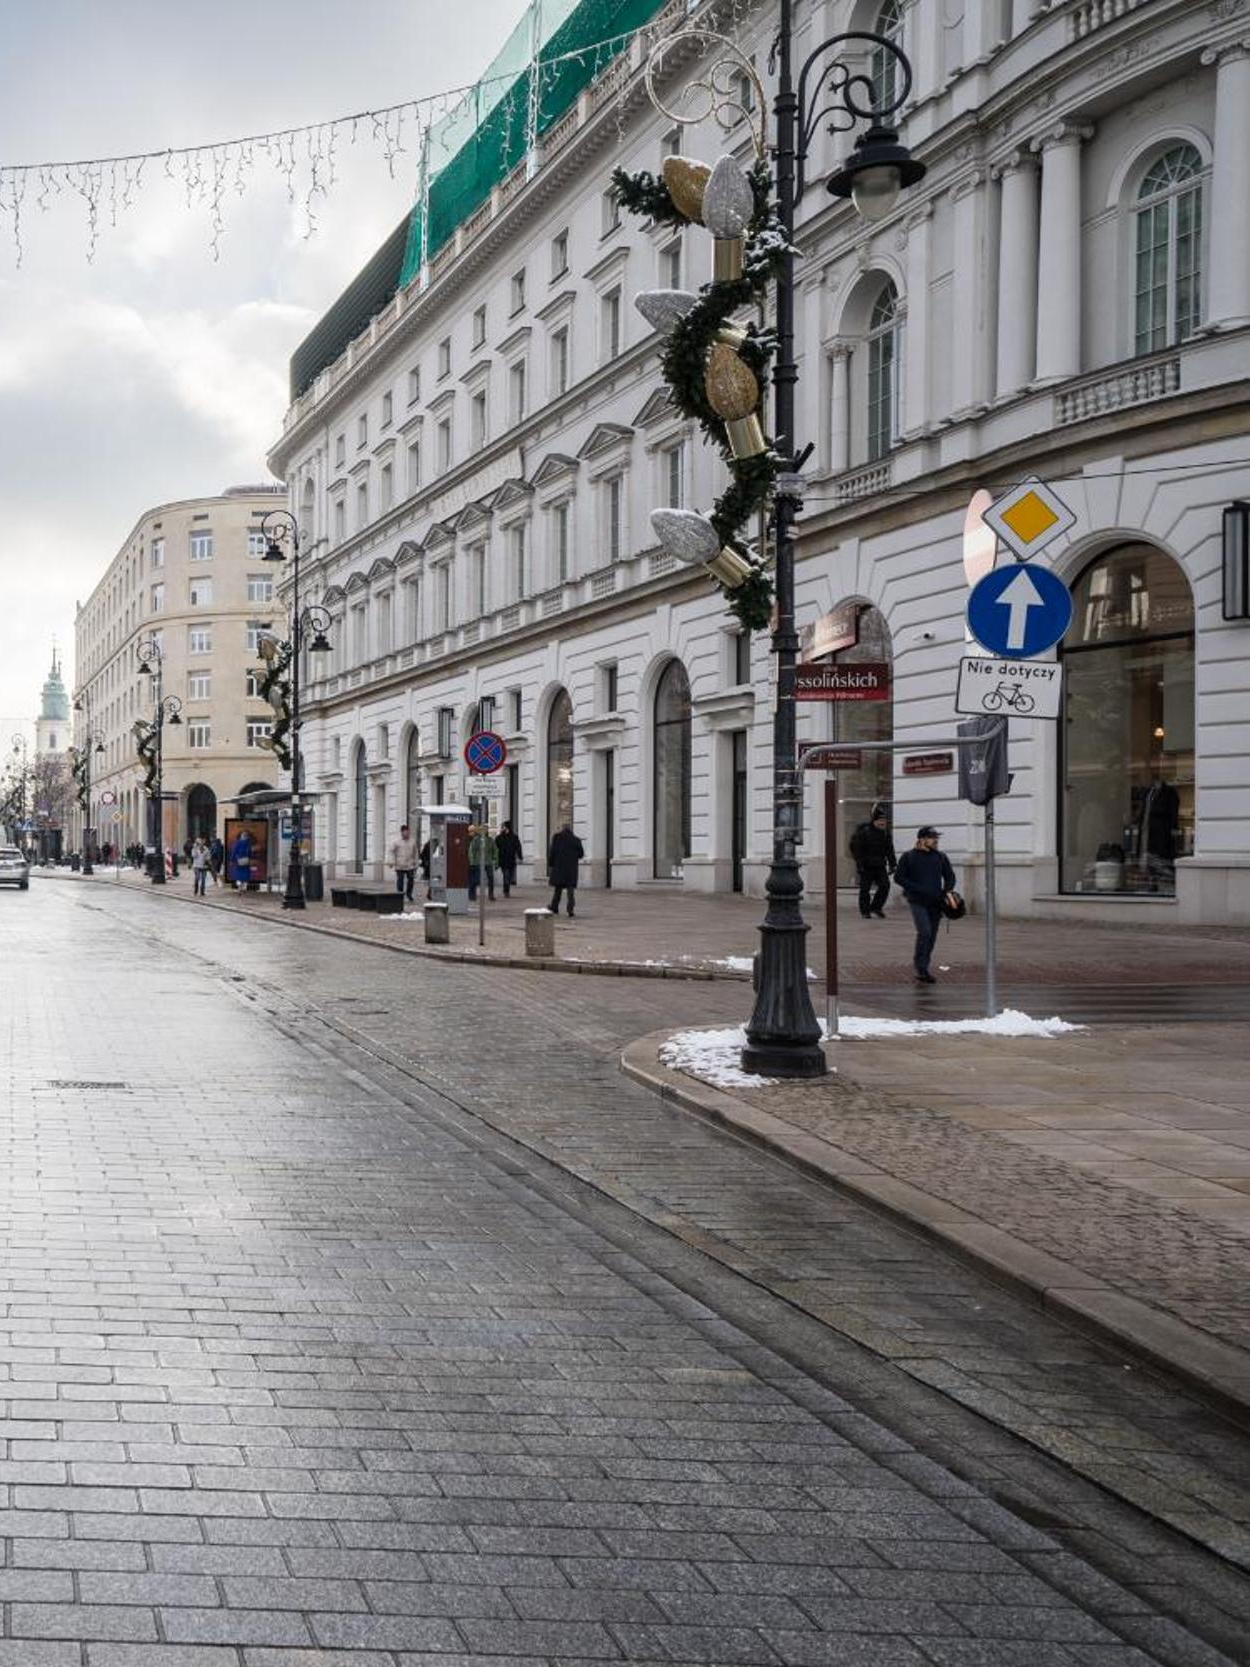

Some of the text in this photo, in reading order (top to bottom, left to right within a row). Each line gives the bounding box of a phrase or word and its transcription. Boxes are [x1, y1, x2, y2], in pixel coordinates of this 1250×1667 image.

[795, 671, 878, 688] ssolińskich
[967, 661, 1055, 681] Nie dotyczy
